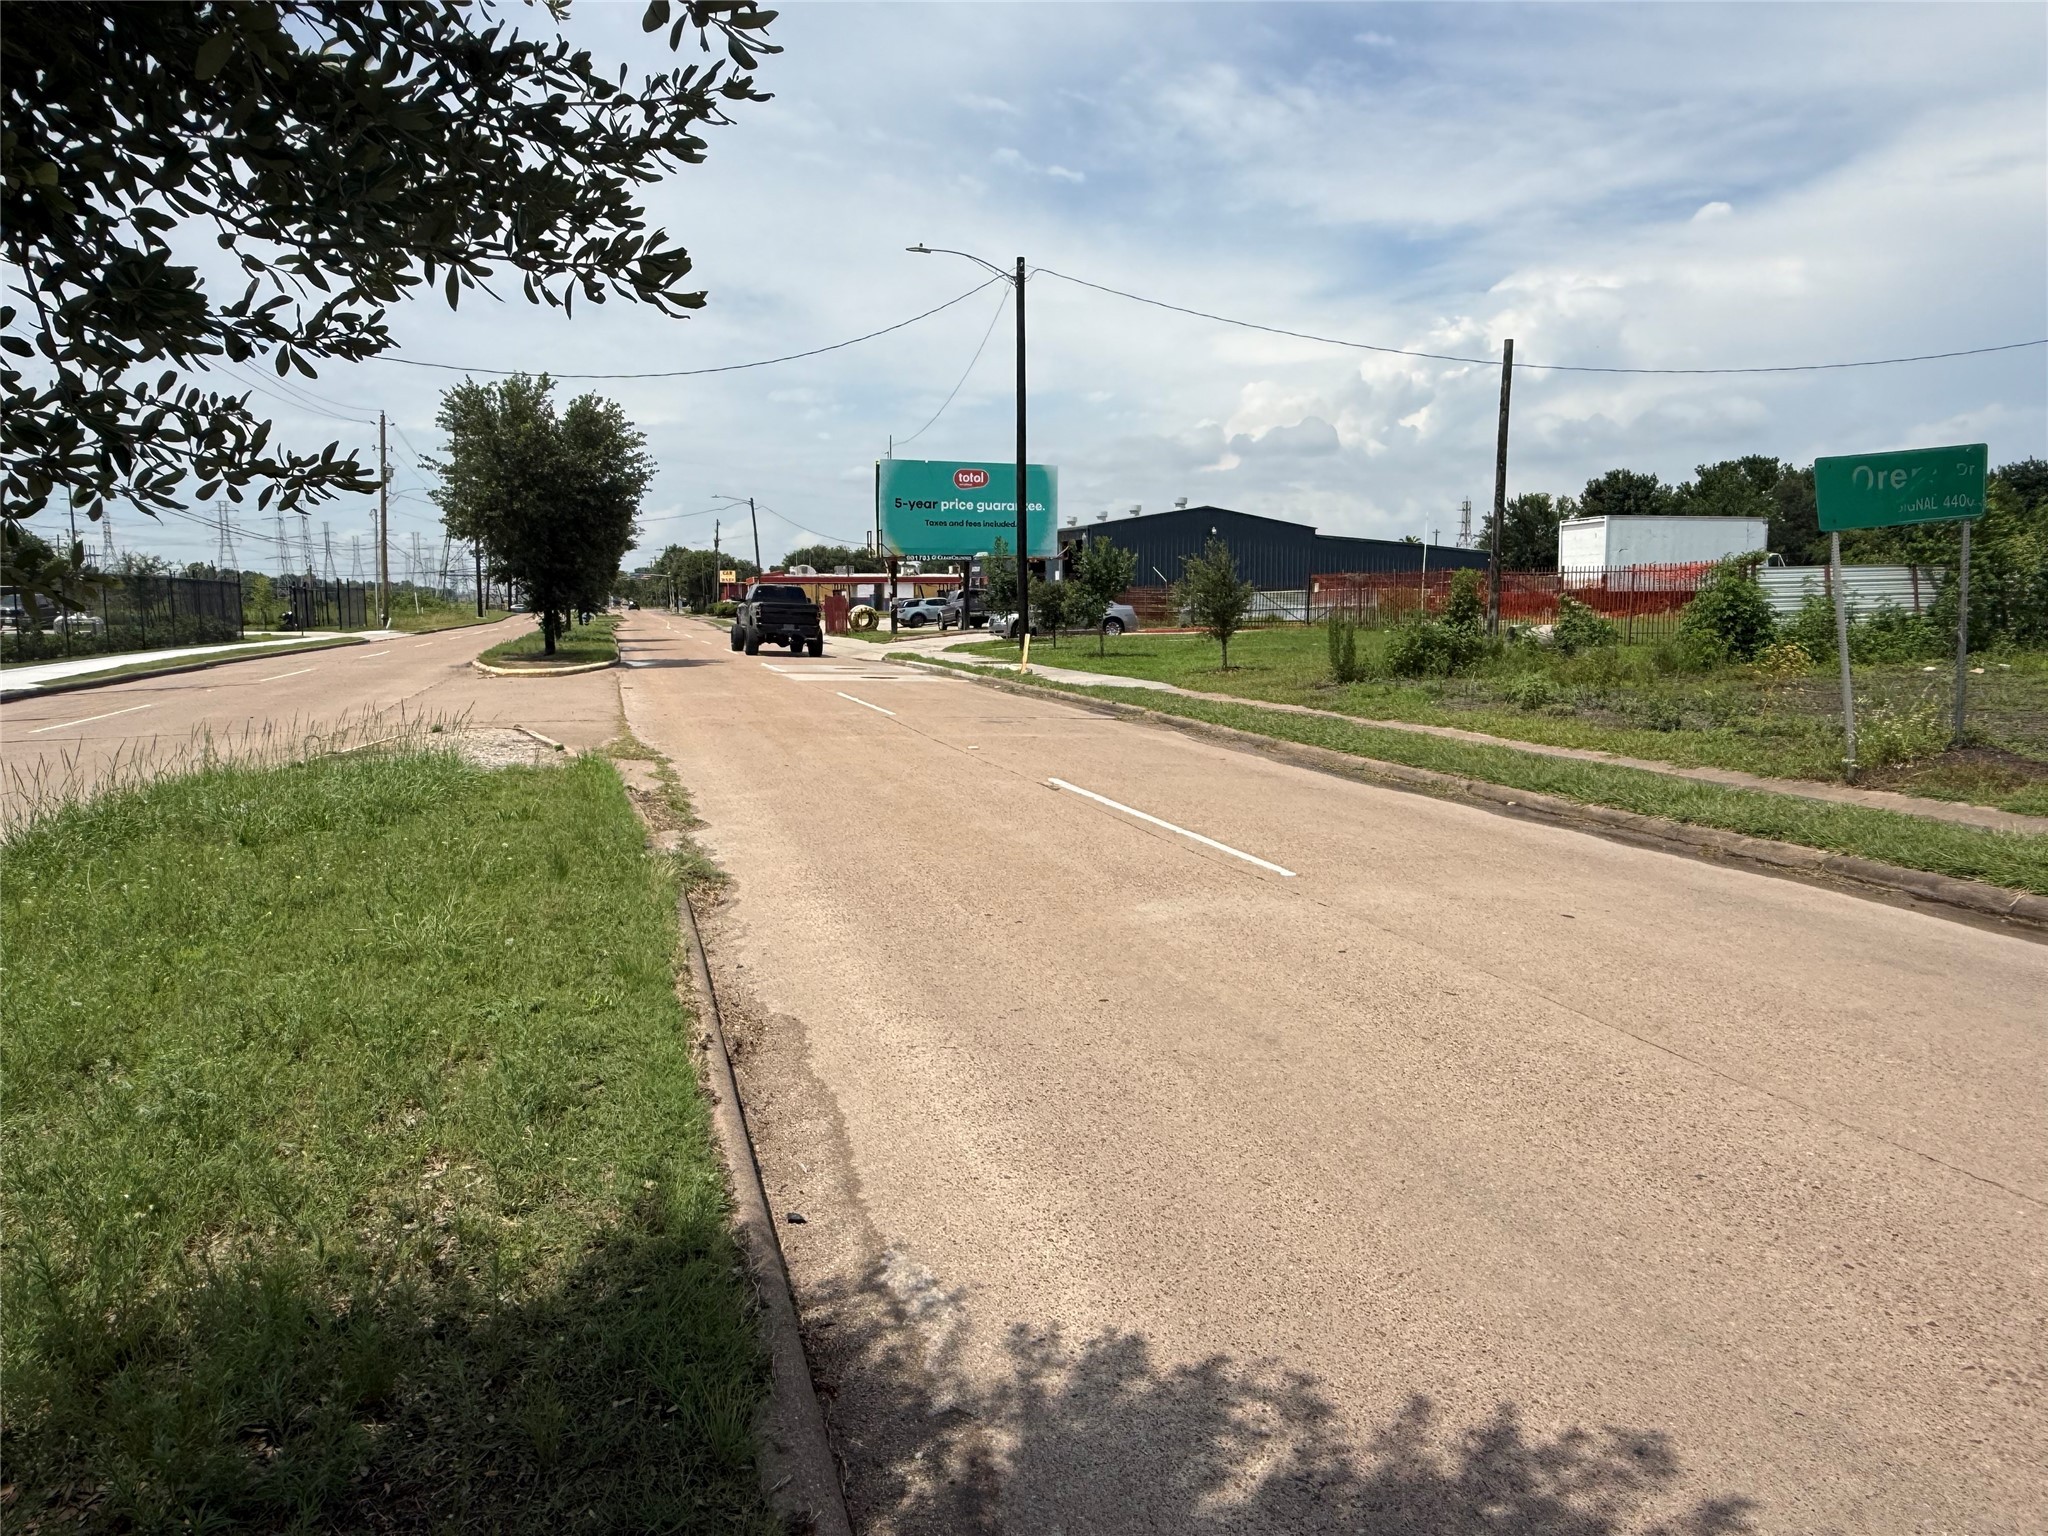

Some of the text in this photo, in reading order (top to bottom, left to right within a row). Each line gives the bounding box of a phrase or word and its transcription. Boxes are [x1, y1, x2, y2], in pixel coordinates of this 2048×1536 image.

[958, 471, 984, 483] total
[895, 498, 1046, 513] 5-year price guaraee.
[925, 519, 947, 527] Taxes
[948, 519, 964, 527] and
